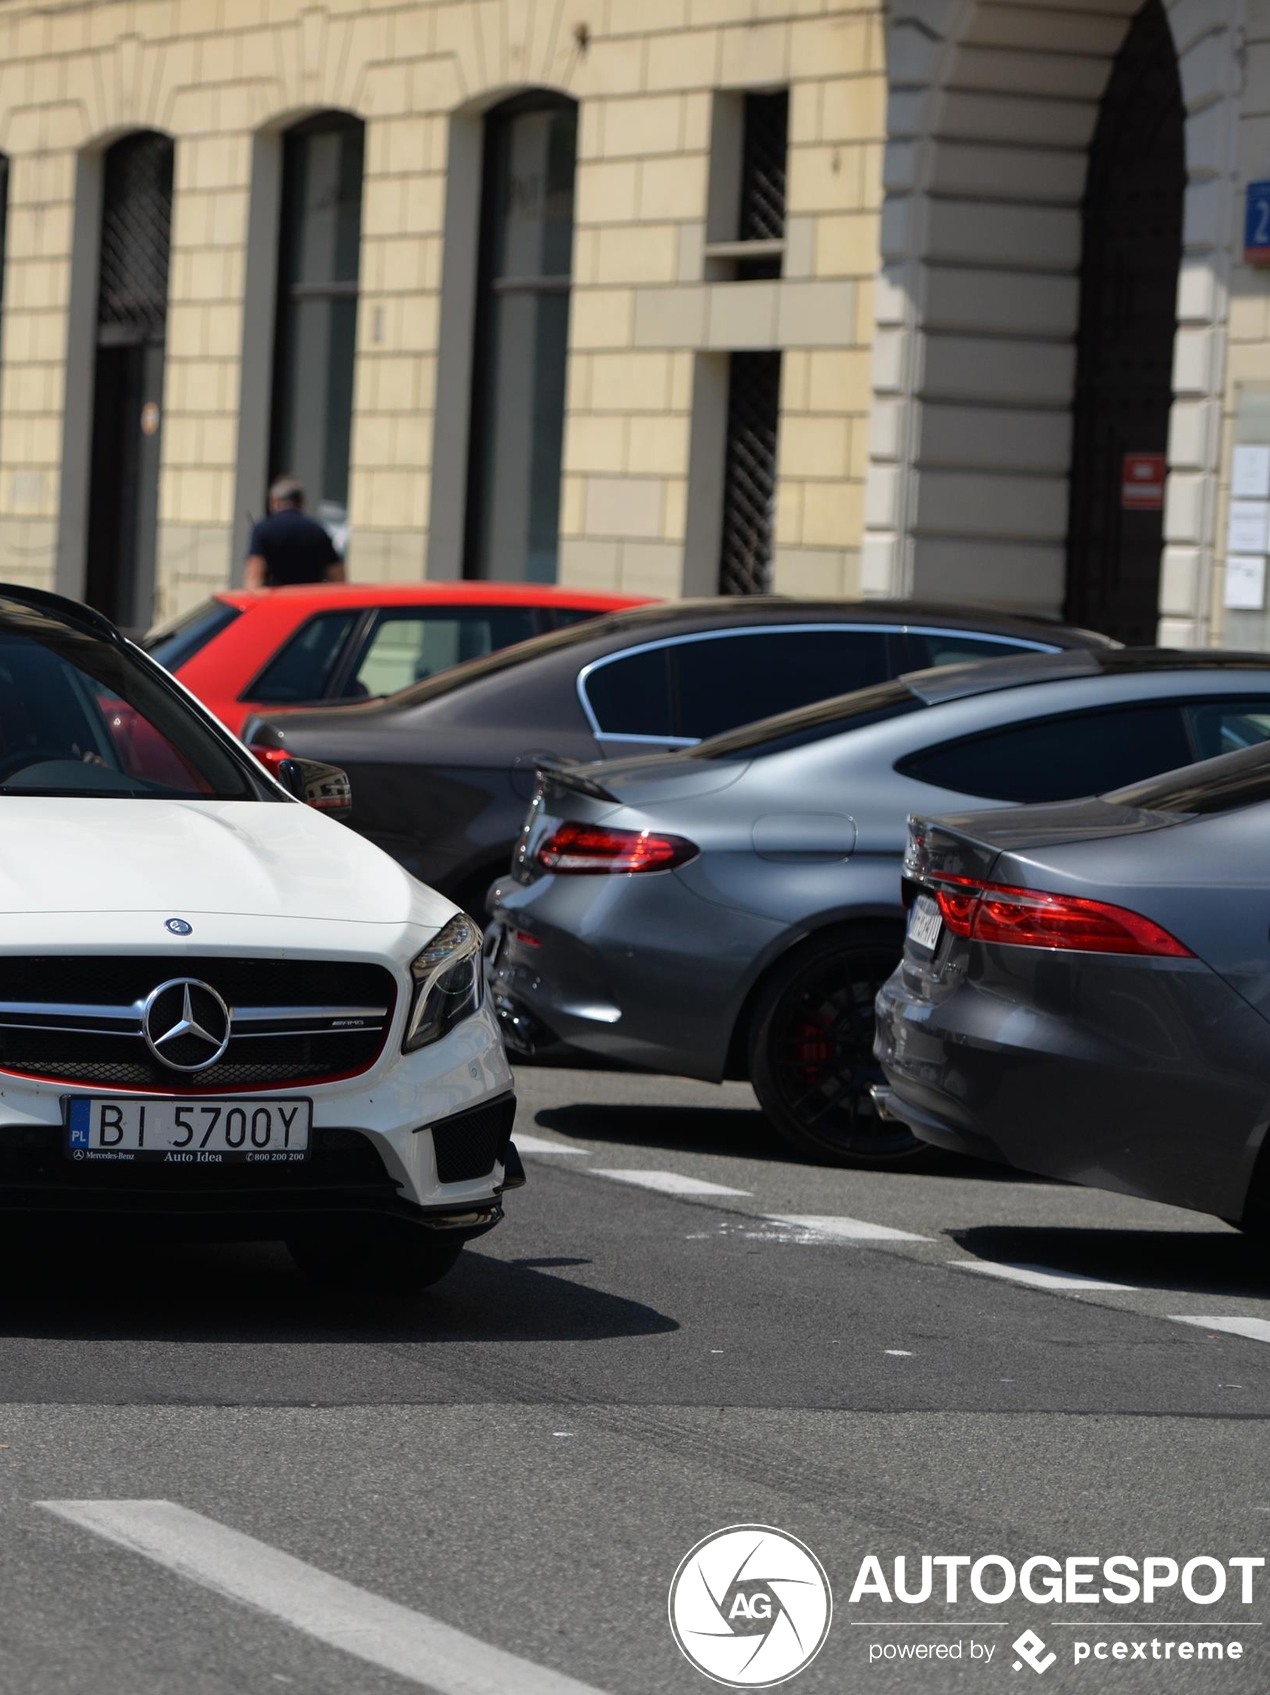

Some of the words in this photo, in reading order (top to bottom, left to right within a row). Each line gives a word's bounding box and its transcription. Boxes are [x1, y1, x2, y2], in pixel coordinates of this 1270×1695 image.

[99, 1104, 146, 1148] BI
[172, 1107, 298, 1149] 5700Y
[72, 1130, 87, 1142] PL
[86, 1151, 135, 1160] Mercedes-Benz
[164, 1151, 193, 1162] Auto
[196, 1151, 223, 1162] Idea
[254, 1153, 270, 1161] 800
[271, 1153, 287, 1161] 200
[288, 1153, 305, 1161] 200
